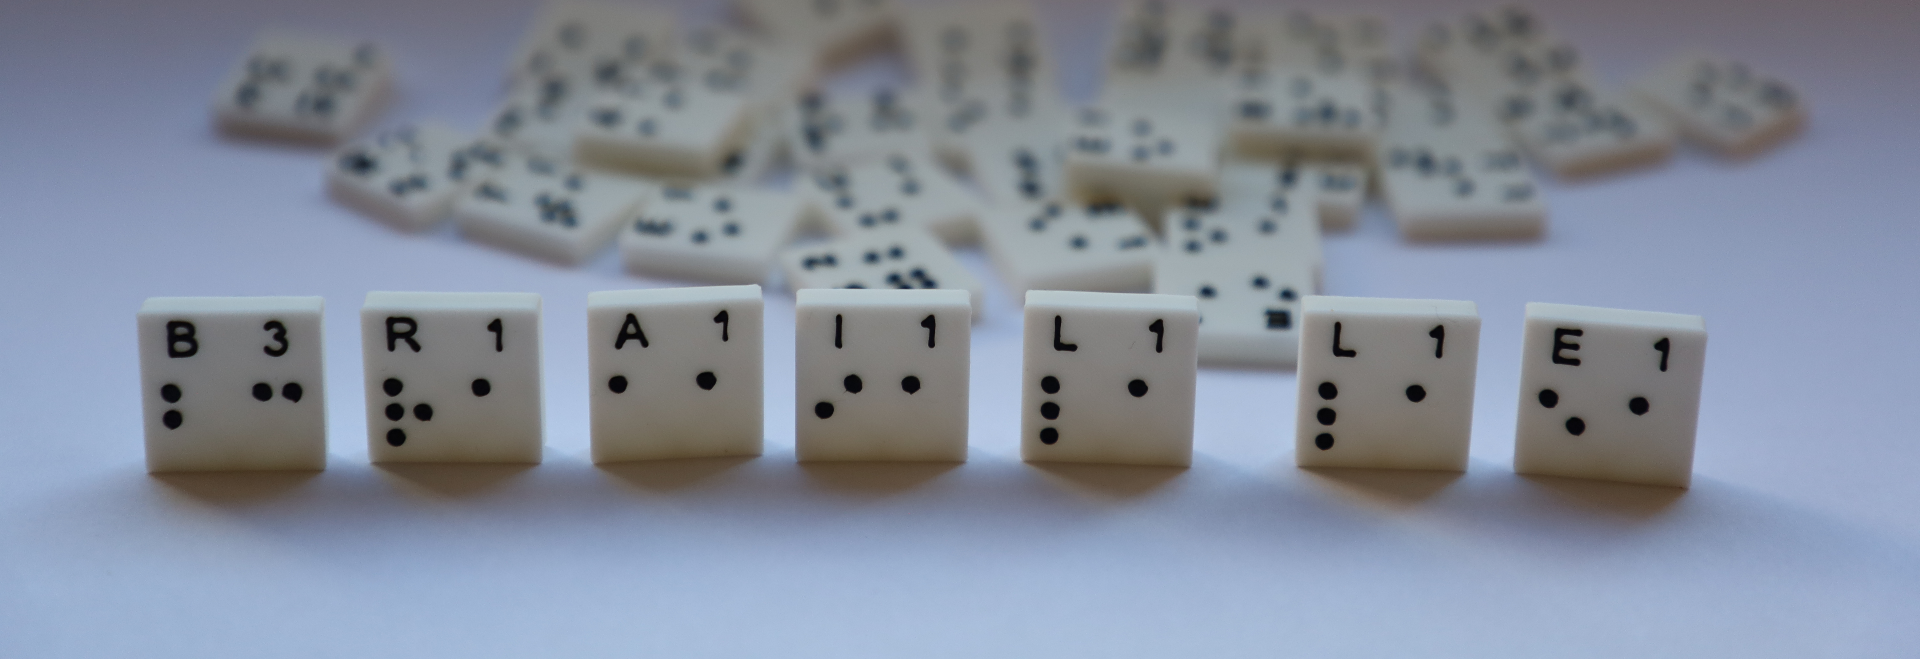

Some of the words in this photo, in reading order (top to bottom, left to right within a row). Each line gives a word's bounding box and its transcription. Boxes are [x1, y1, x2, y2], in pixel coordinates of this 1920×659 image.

[165, 319, 200, 359] B
[262, 319, 290, 358] 3
[384, 315, 422, 353] R
[486, 317, 504, 353] 1
[614, 312, 650, 351] A
[713, 309, 730, 343] 1
[833, 314, 844, 350] I
[920, 314, 937, 349] 1
[1053, 314, 1079, 353] L
[1148, 318, 1165, 354] 1
[1332, 321, 1358, 359] L
[1428, 324, 1446, 360] 1
[1551, 327, 1584, 367] E
[1653, 336, 1671, 373] 1
